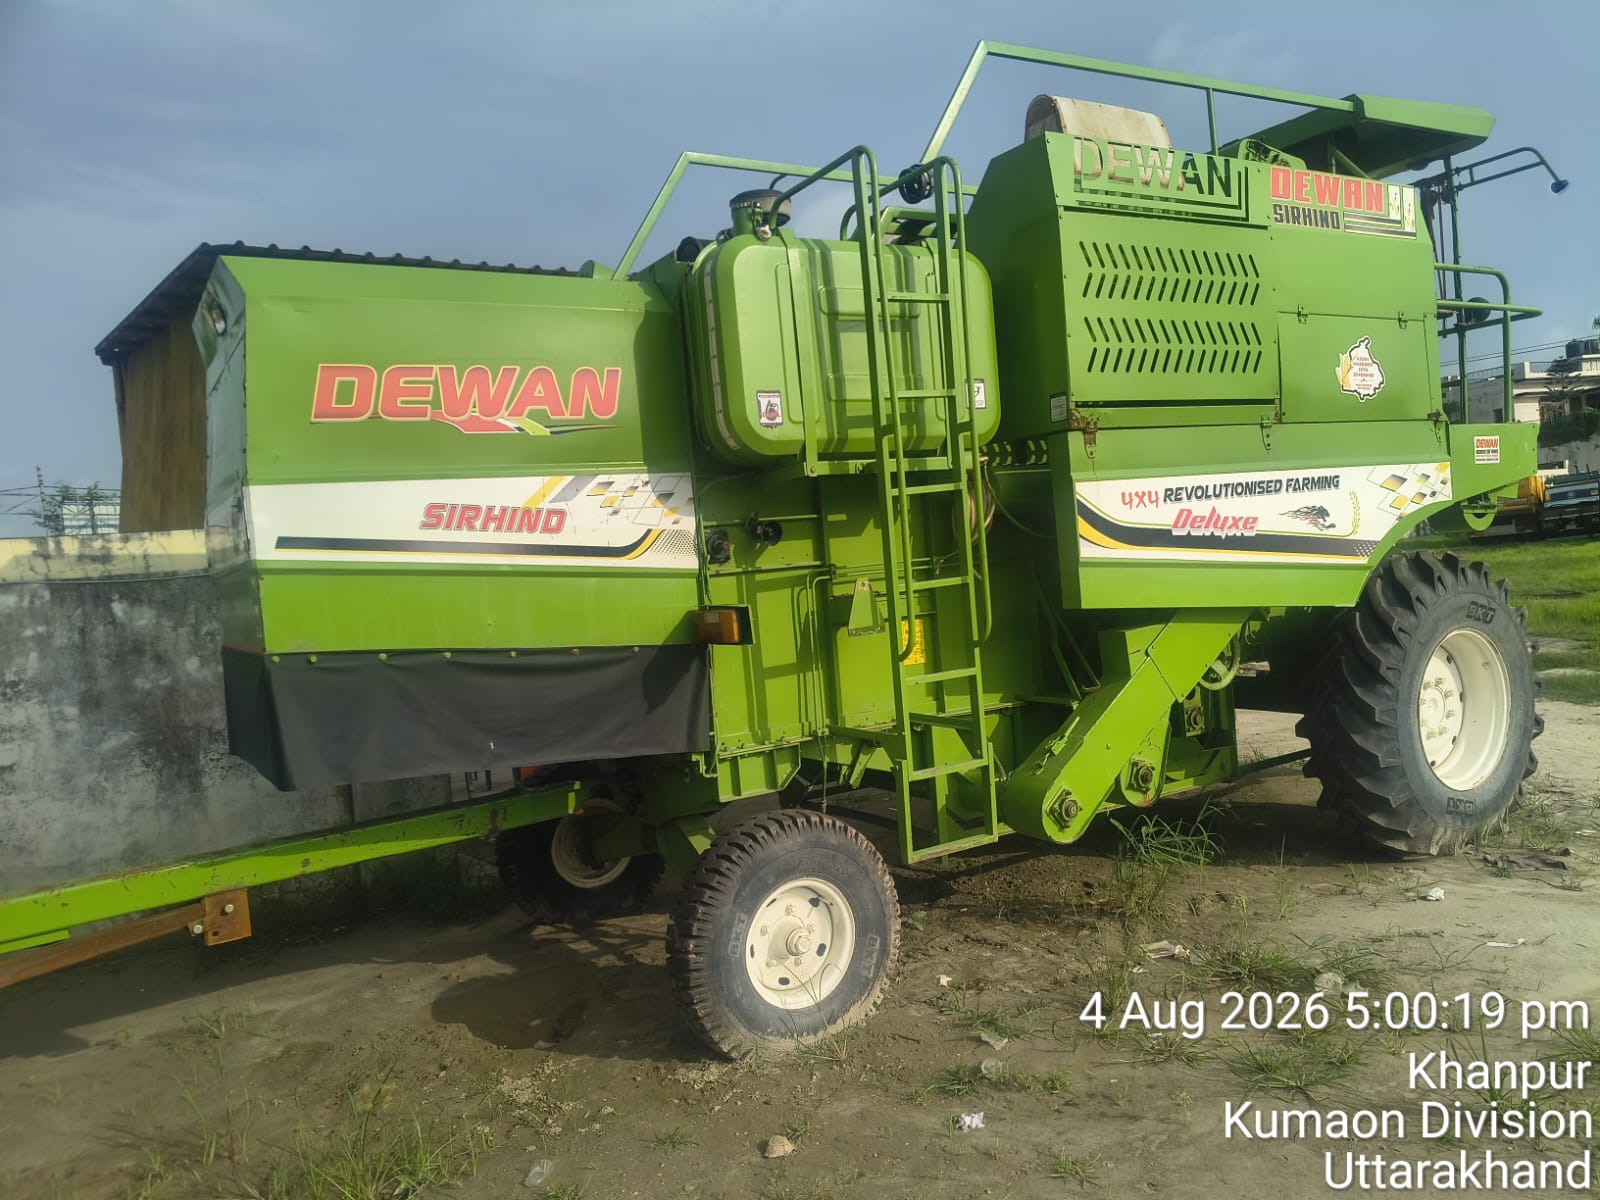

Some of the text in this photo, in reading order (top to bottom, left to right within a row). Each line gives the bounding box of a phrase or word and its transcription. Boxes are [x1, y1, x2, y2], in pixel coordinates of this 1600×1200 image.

[1074, 137, 1232, 197] DEWAN
[1270, 166, 1384, 213] DEWAN
[1272, 203, 1341, 230] SIRHIND
[311, 363, 622, 421] DEWAN
[1476, 438, 1499, 448] DEWAN
[1163, 478, 1283, 503] REVOLUTIONISED
[1285, 474, 1340, 493] FARMING
[419, 502, 568, 534] SIRHIND
[1172, 505, 1259, 537] Deluxe
[728, 913, 748, 957] BKT
[862, 935, 881, 977] BKT
